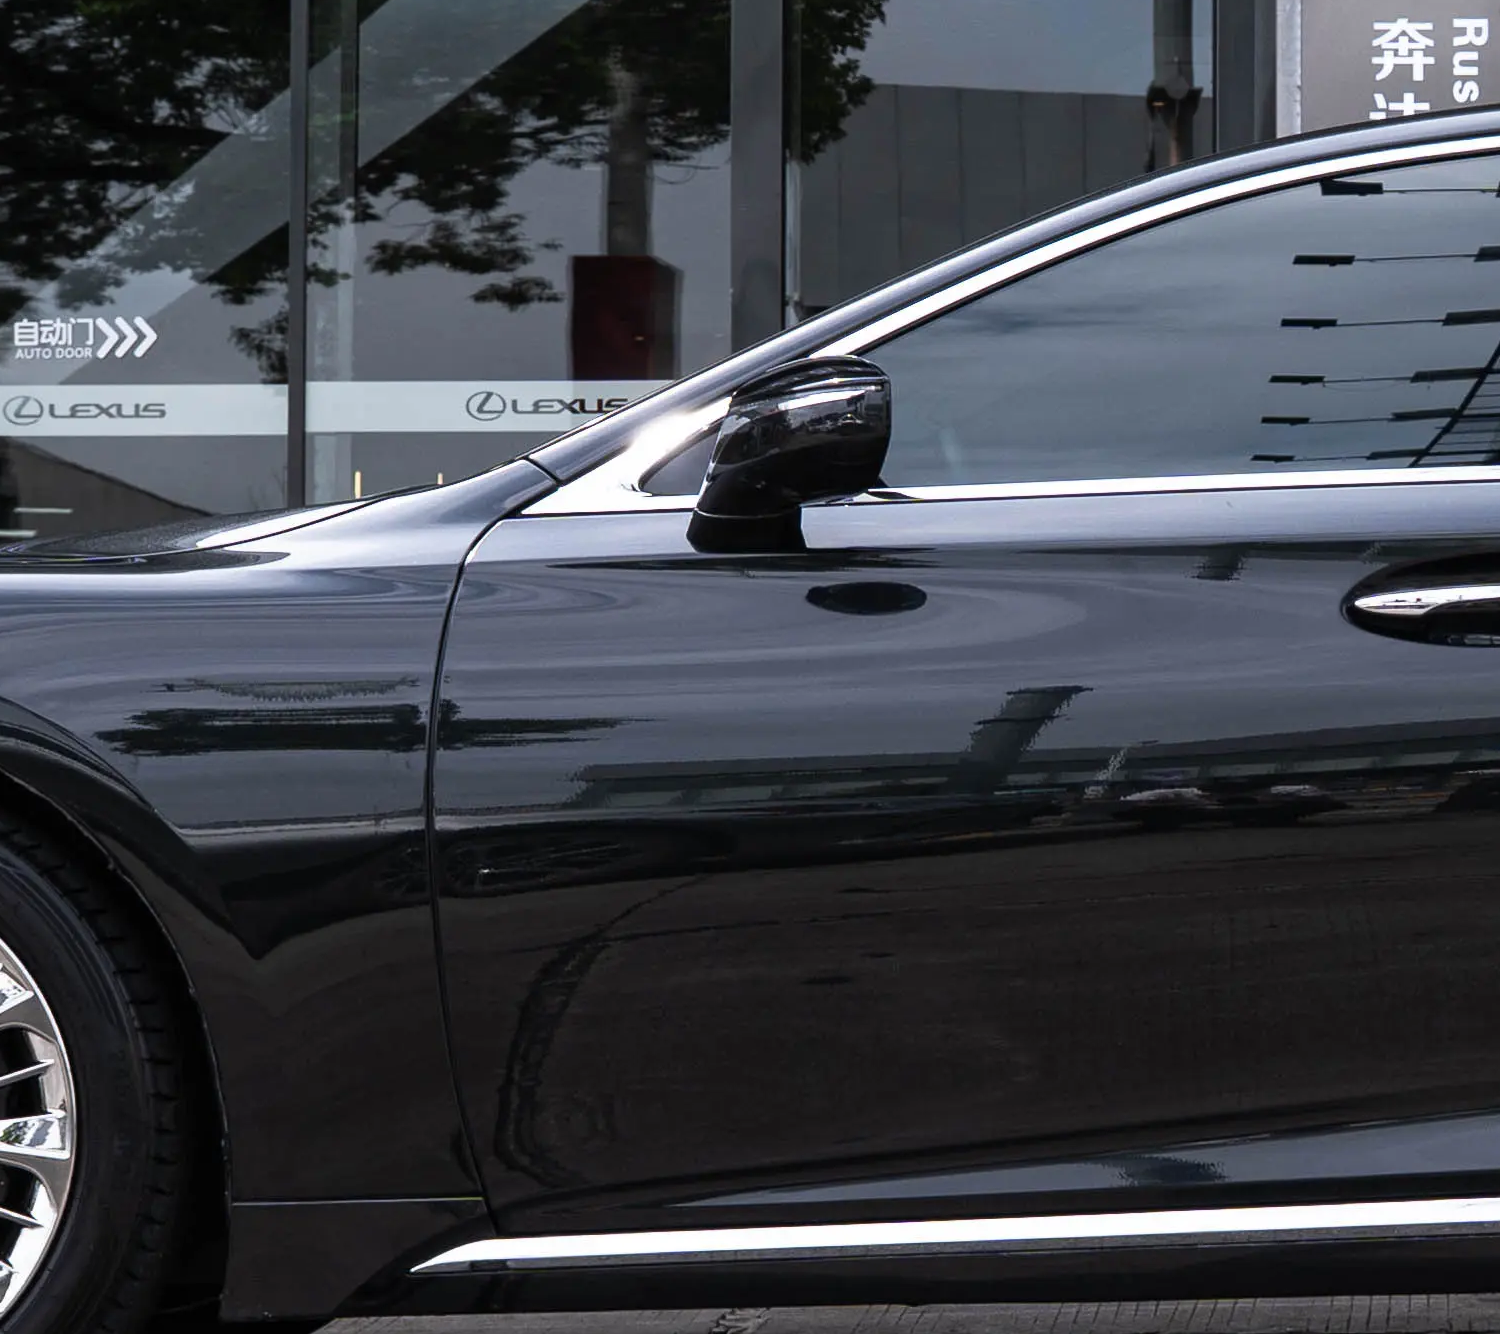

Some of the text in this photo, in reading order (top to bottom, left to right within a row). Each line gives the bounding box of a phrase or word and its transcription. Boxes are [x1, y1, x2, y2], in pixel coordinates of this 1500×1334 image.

[13, 317, 95, 346] 自动门
[15, 348, 93, 359] AUTO DOOR
[48, 403, 167, 418] LEXUS
[510, 398, 629, 415] LEXUS
